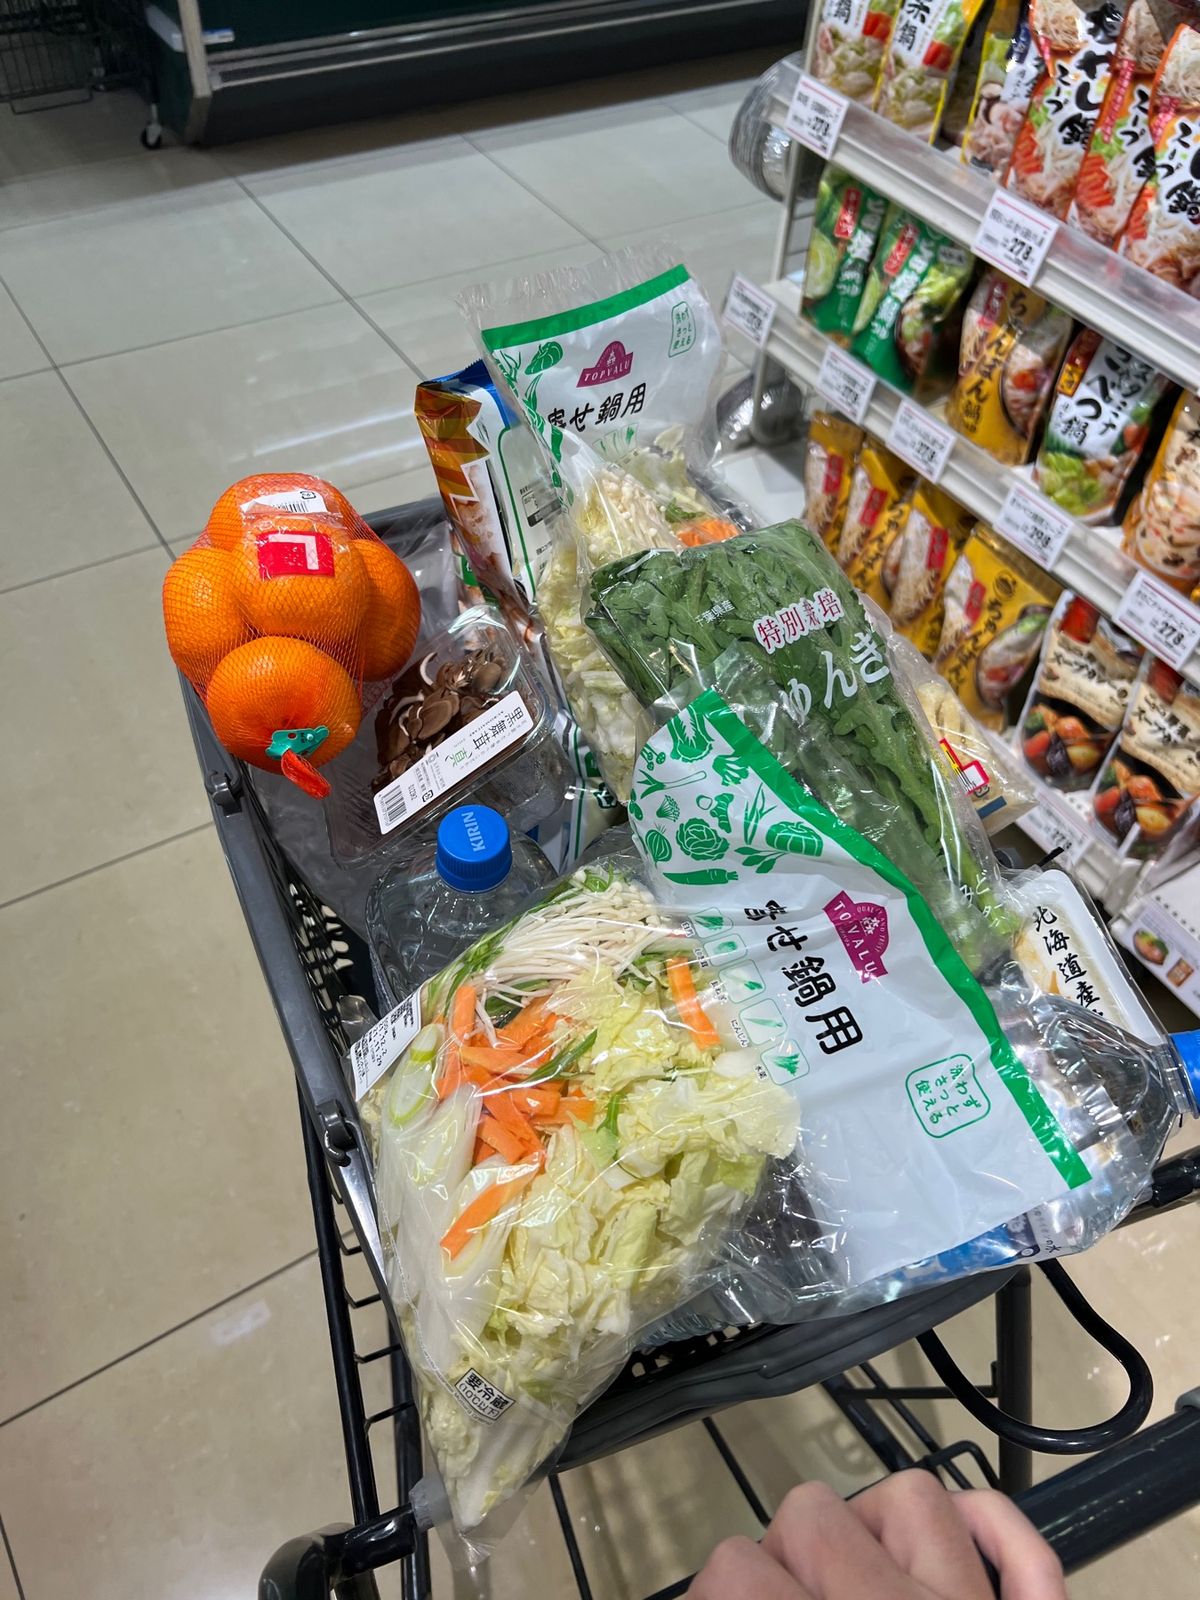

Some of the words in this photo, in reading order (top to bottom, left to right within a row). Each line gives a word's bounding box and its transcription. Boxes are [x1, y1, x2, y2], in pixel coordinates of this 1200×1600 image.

[584, 359, 630, 383] TOPVALU
[695, 599, 736, 627] 千葉県産
[757, 590, 842, 650] 特別栽培
[461, 811, 486, 853] KIRIN
[731, 1018, 748, 1047] にんじん
[914, 1080, 943, 1125] 使える
[934, 1075, 960, 1117] さっと
[949, 1063, 982, 1108] 洗わず
[464, 1372, 510, 1410] 要冷蔵
